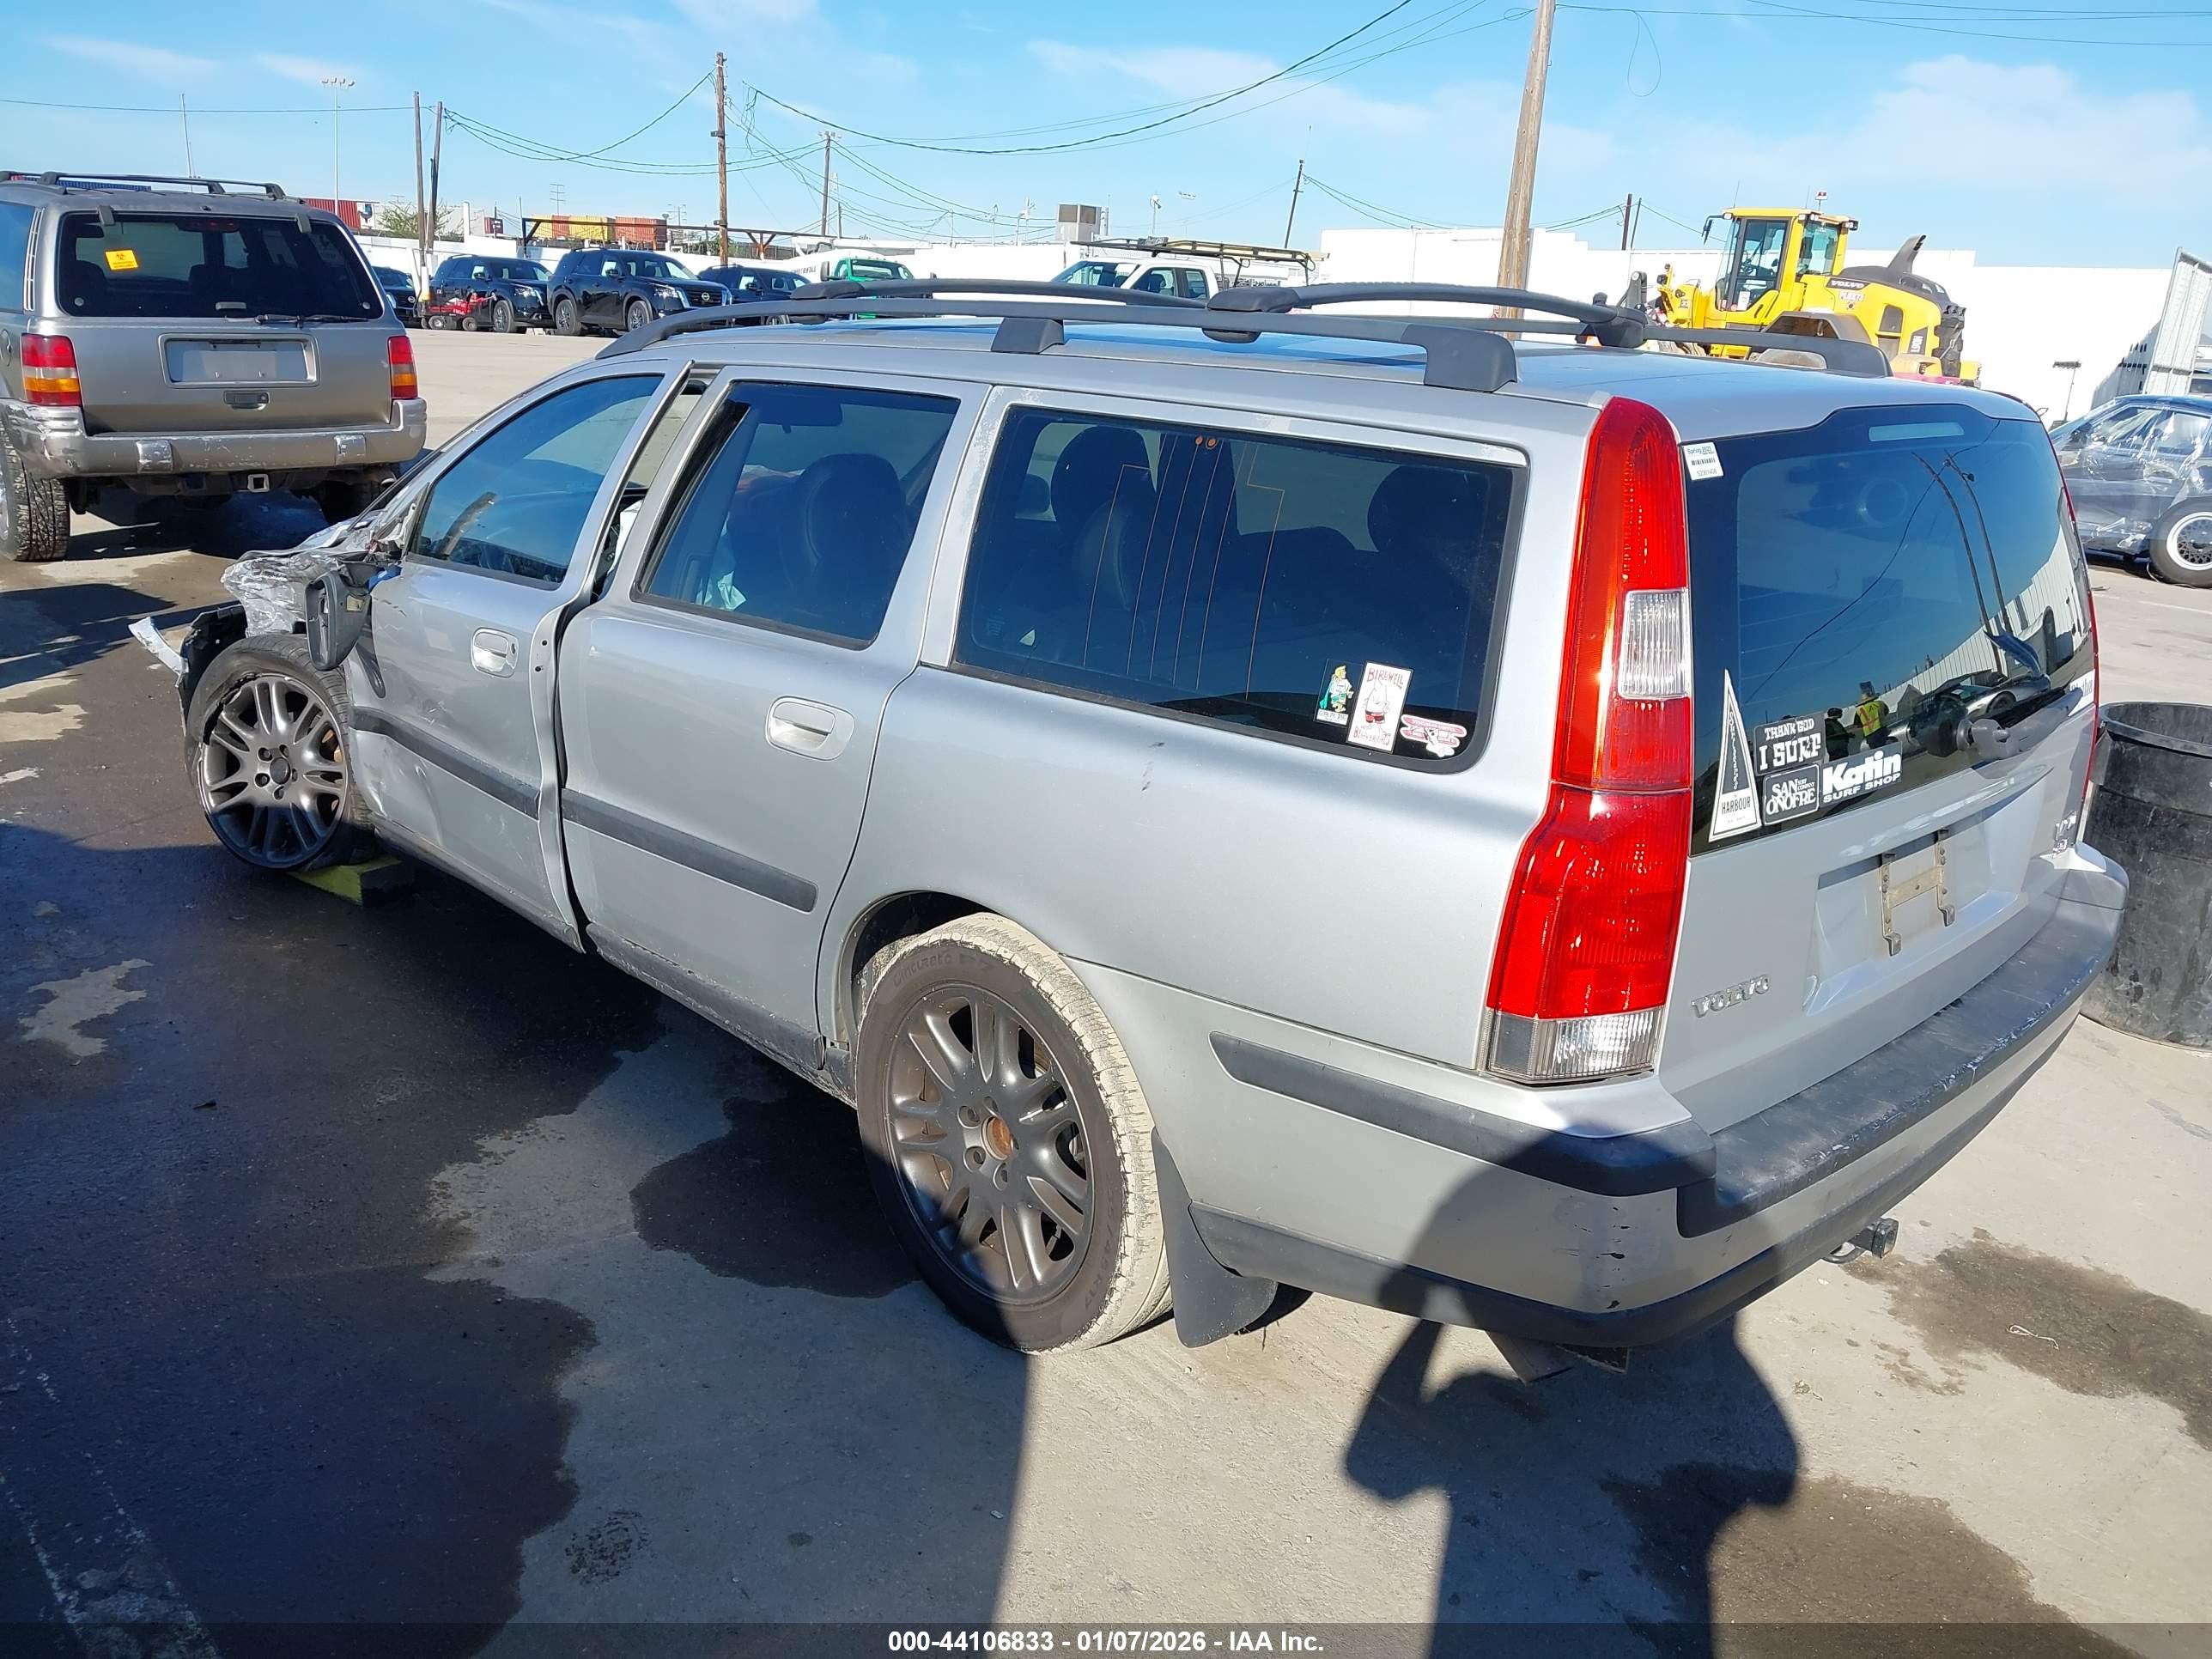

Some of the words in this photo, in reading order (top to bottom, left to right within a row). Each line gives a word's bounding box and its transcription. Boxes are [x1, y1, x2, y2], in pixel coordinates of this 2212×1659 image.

[1831, 280, 1865, 289] VOLVO
[1367, 668, 1404, 690] BIRDWELL
[1765, 722, 1796, 741] THANK
[1796, 718, 1814, 733] GOD
[1759, 744, 1769, 771] I
[1772, 732, 1820, 767] SURF
[1822, 750, 1901, 796] Katin
[1771, 778, 1800, 798] SAN
[1823, 785, 1862, 804] SURF
[1864, 772, 1901, 790] SHOP
[1721, 796, 1751, 815] HARBOUR
[1765, 787, 1816, 815] ONOFRE
[1690, 974, 1769, 1018] VOLVO
